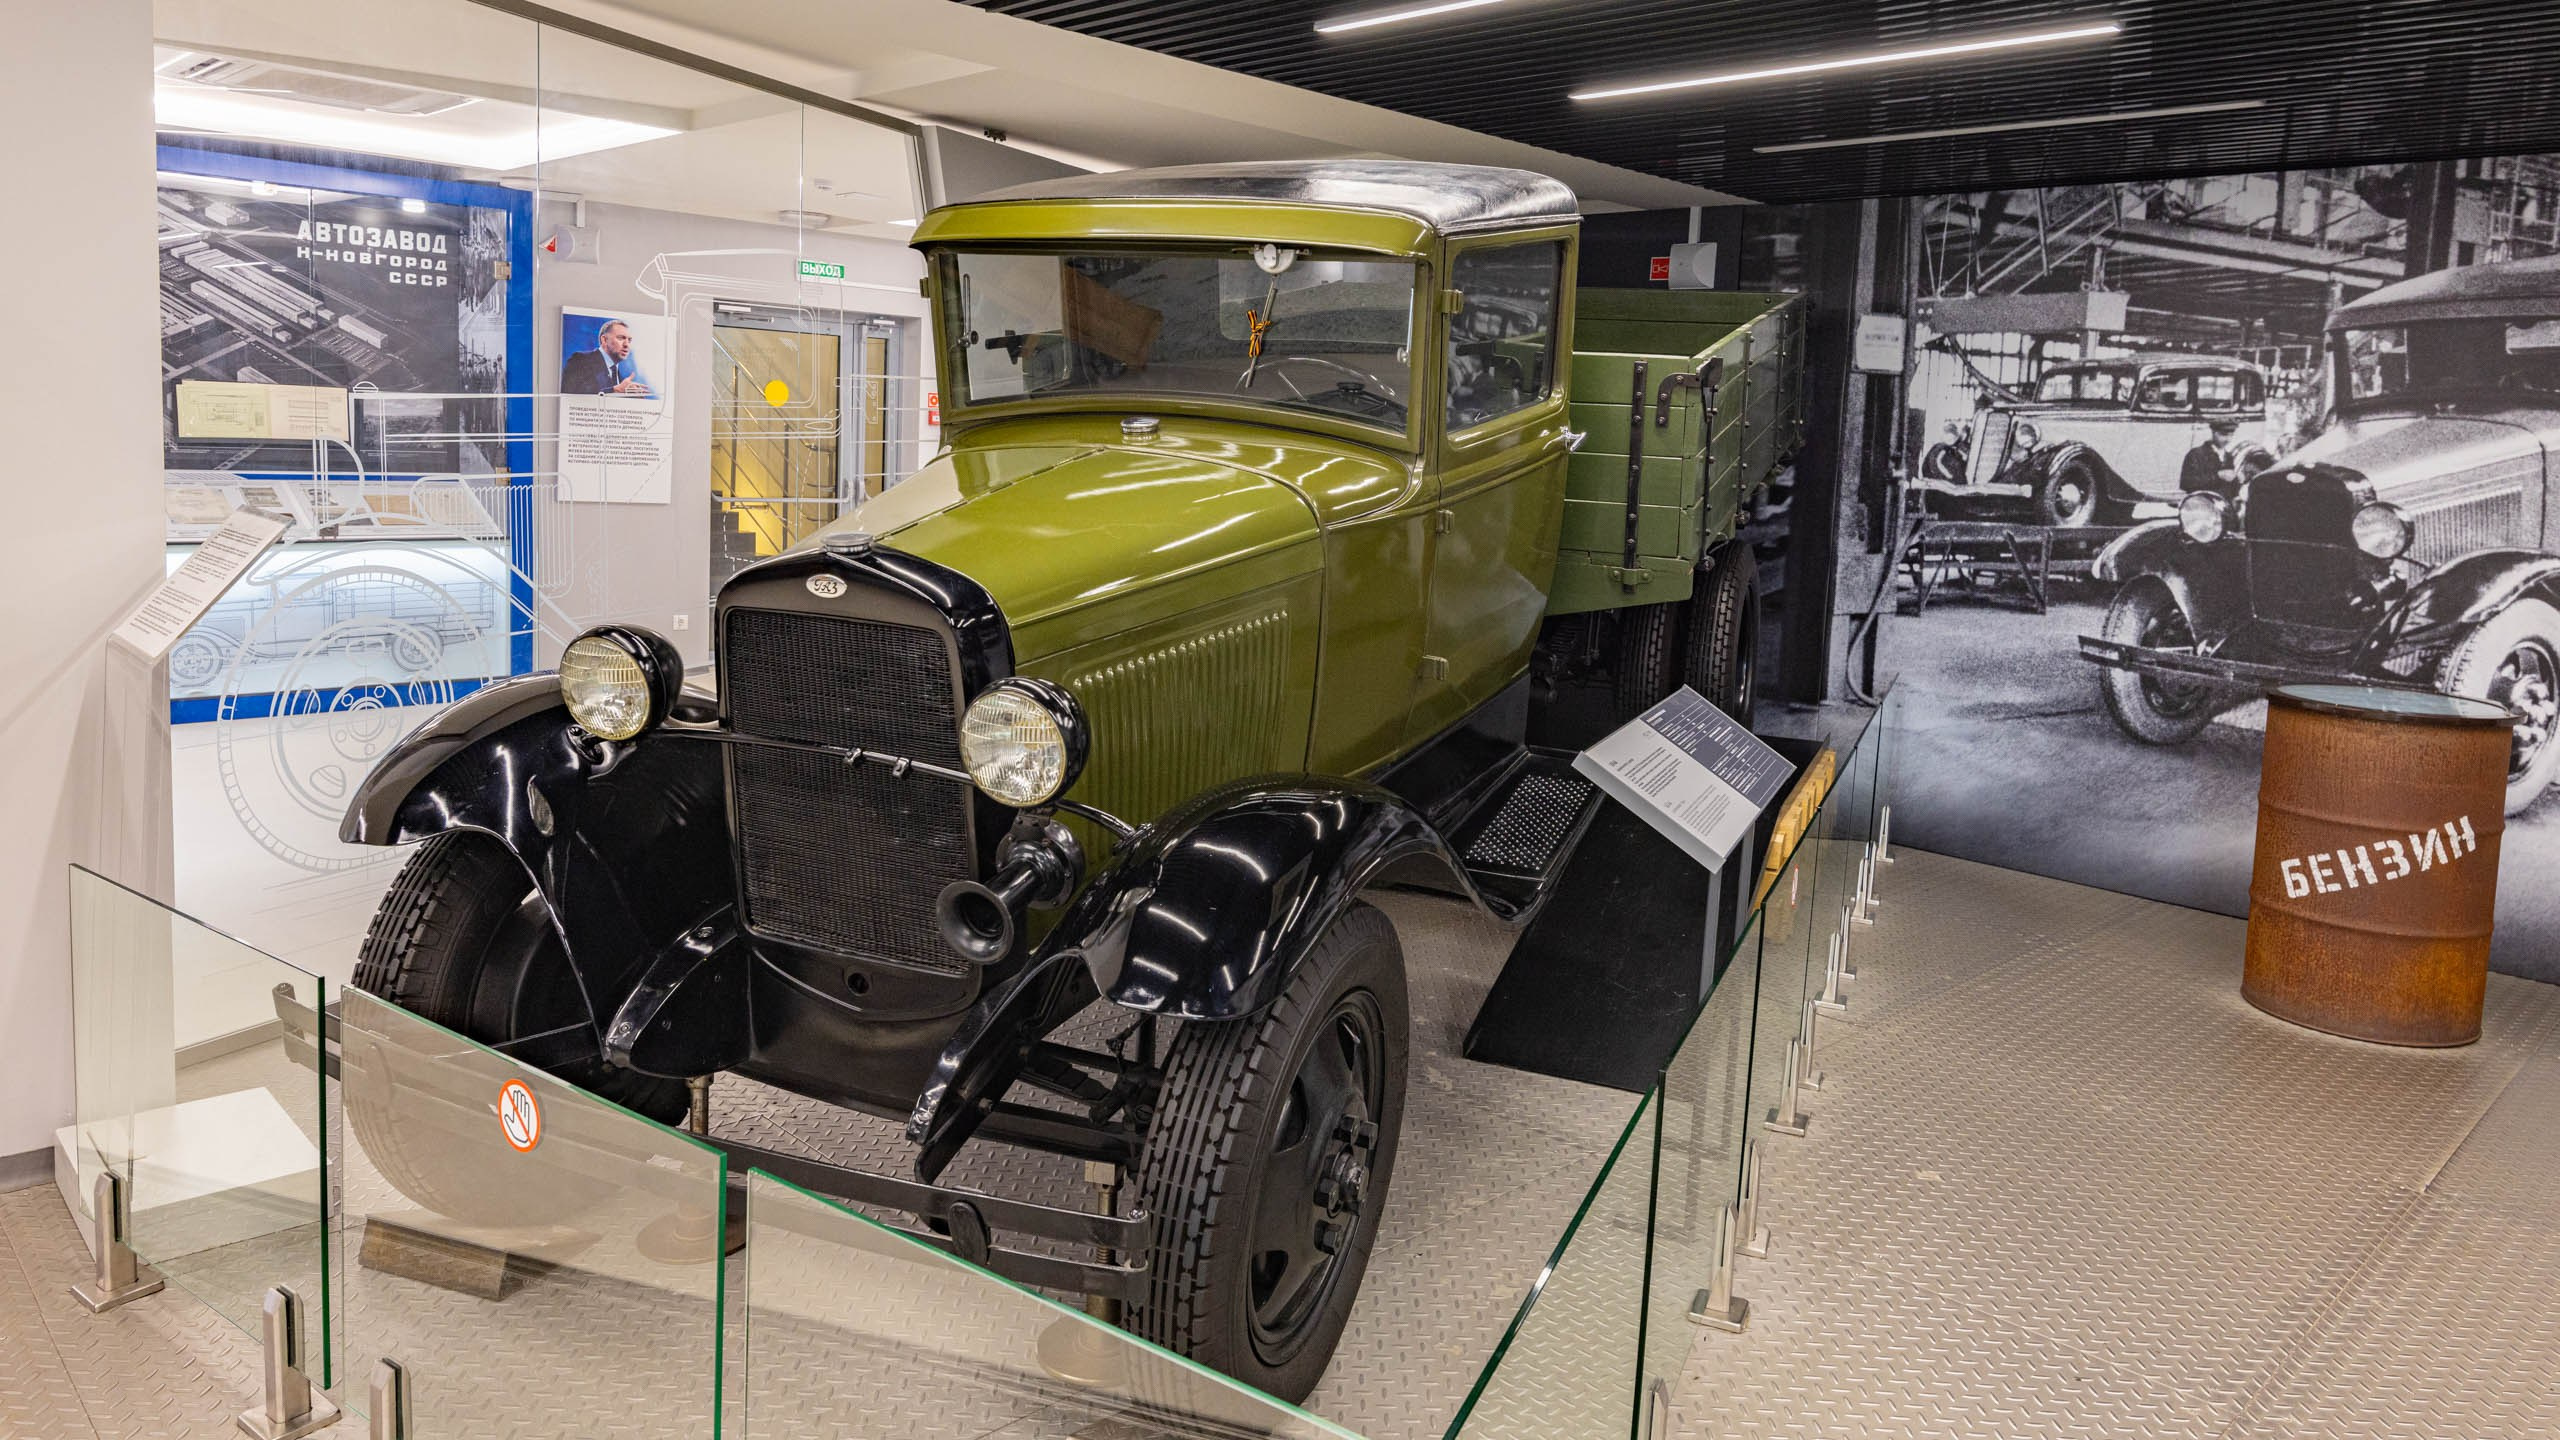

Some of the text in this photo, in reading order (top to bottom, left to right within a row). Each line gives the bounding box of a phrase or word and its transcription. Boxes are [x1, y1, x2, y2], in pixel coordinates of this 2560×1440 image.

[296, 220, 448, 254] АВТОЗАВОД
[296, 246, 448, 271] Н-НОВГОРОД
[389, 271, 448, 287] СССР
[802, 262, 841, 277] ВЫХОД
[813, 578, 838, 595] ГАЗ
[2280, 815, 2476, 898] БЕНЗИН
